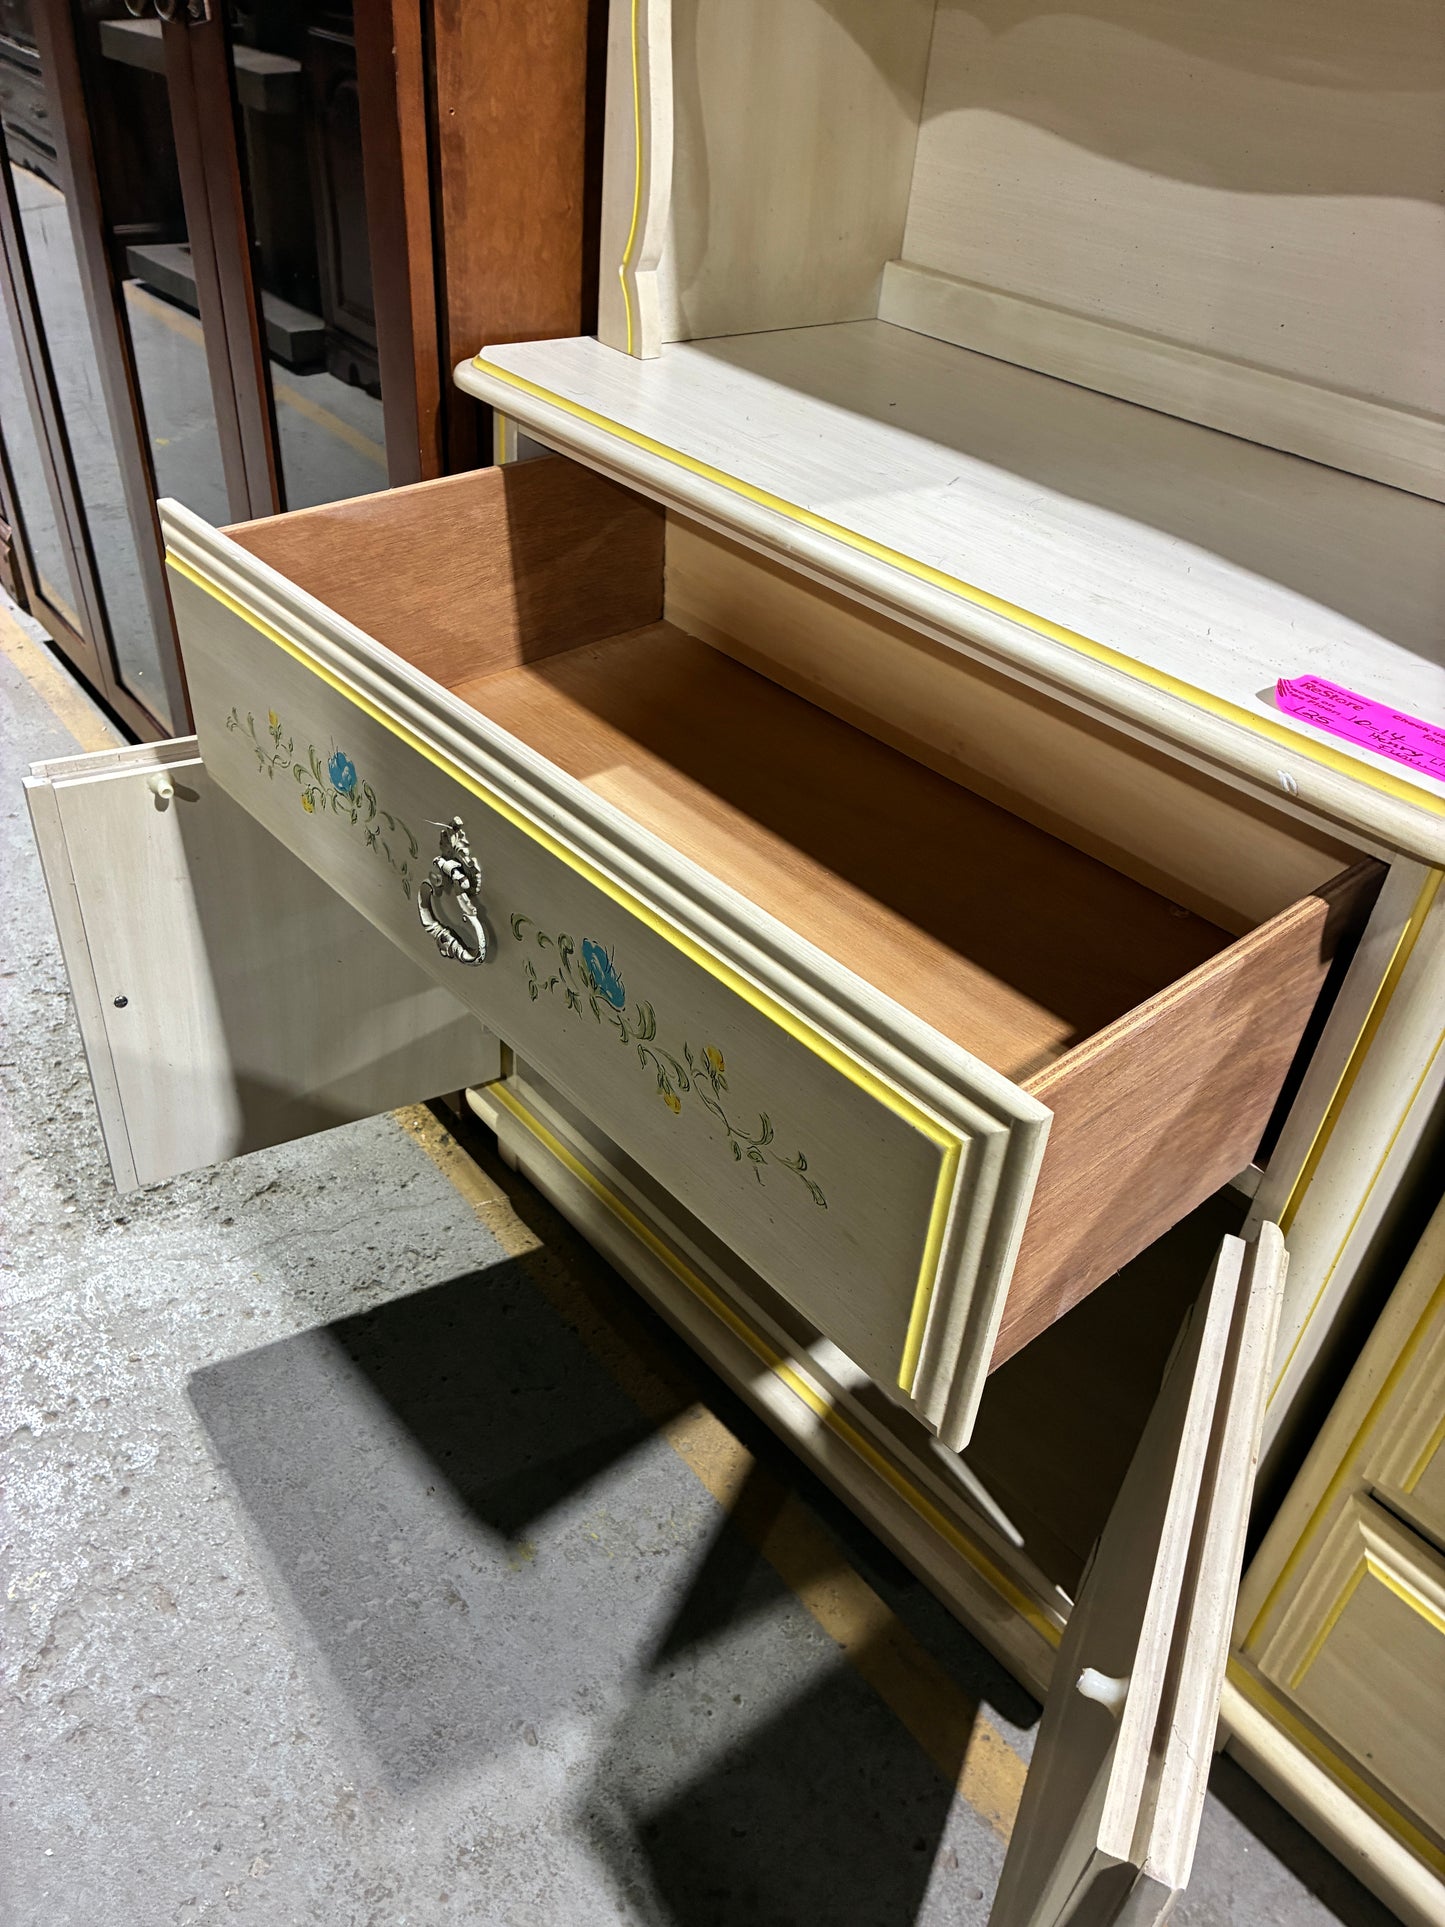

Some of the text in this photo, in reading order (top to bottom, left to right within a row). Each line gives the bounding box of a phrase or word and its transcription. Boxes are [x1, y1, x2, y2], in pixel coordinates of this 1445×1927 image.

[1299, 682, 1364, 711] ReStore
[1292, 706, 1335, 724] 125
[1391, 714, 1431, 732] Check
[1347, 715, 1406, 742] 10-14
[1367, 732, 1424, 757] Henry
